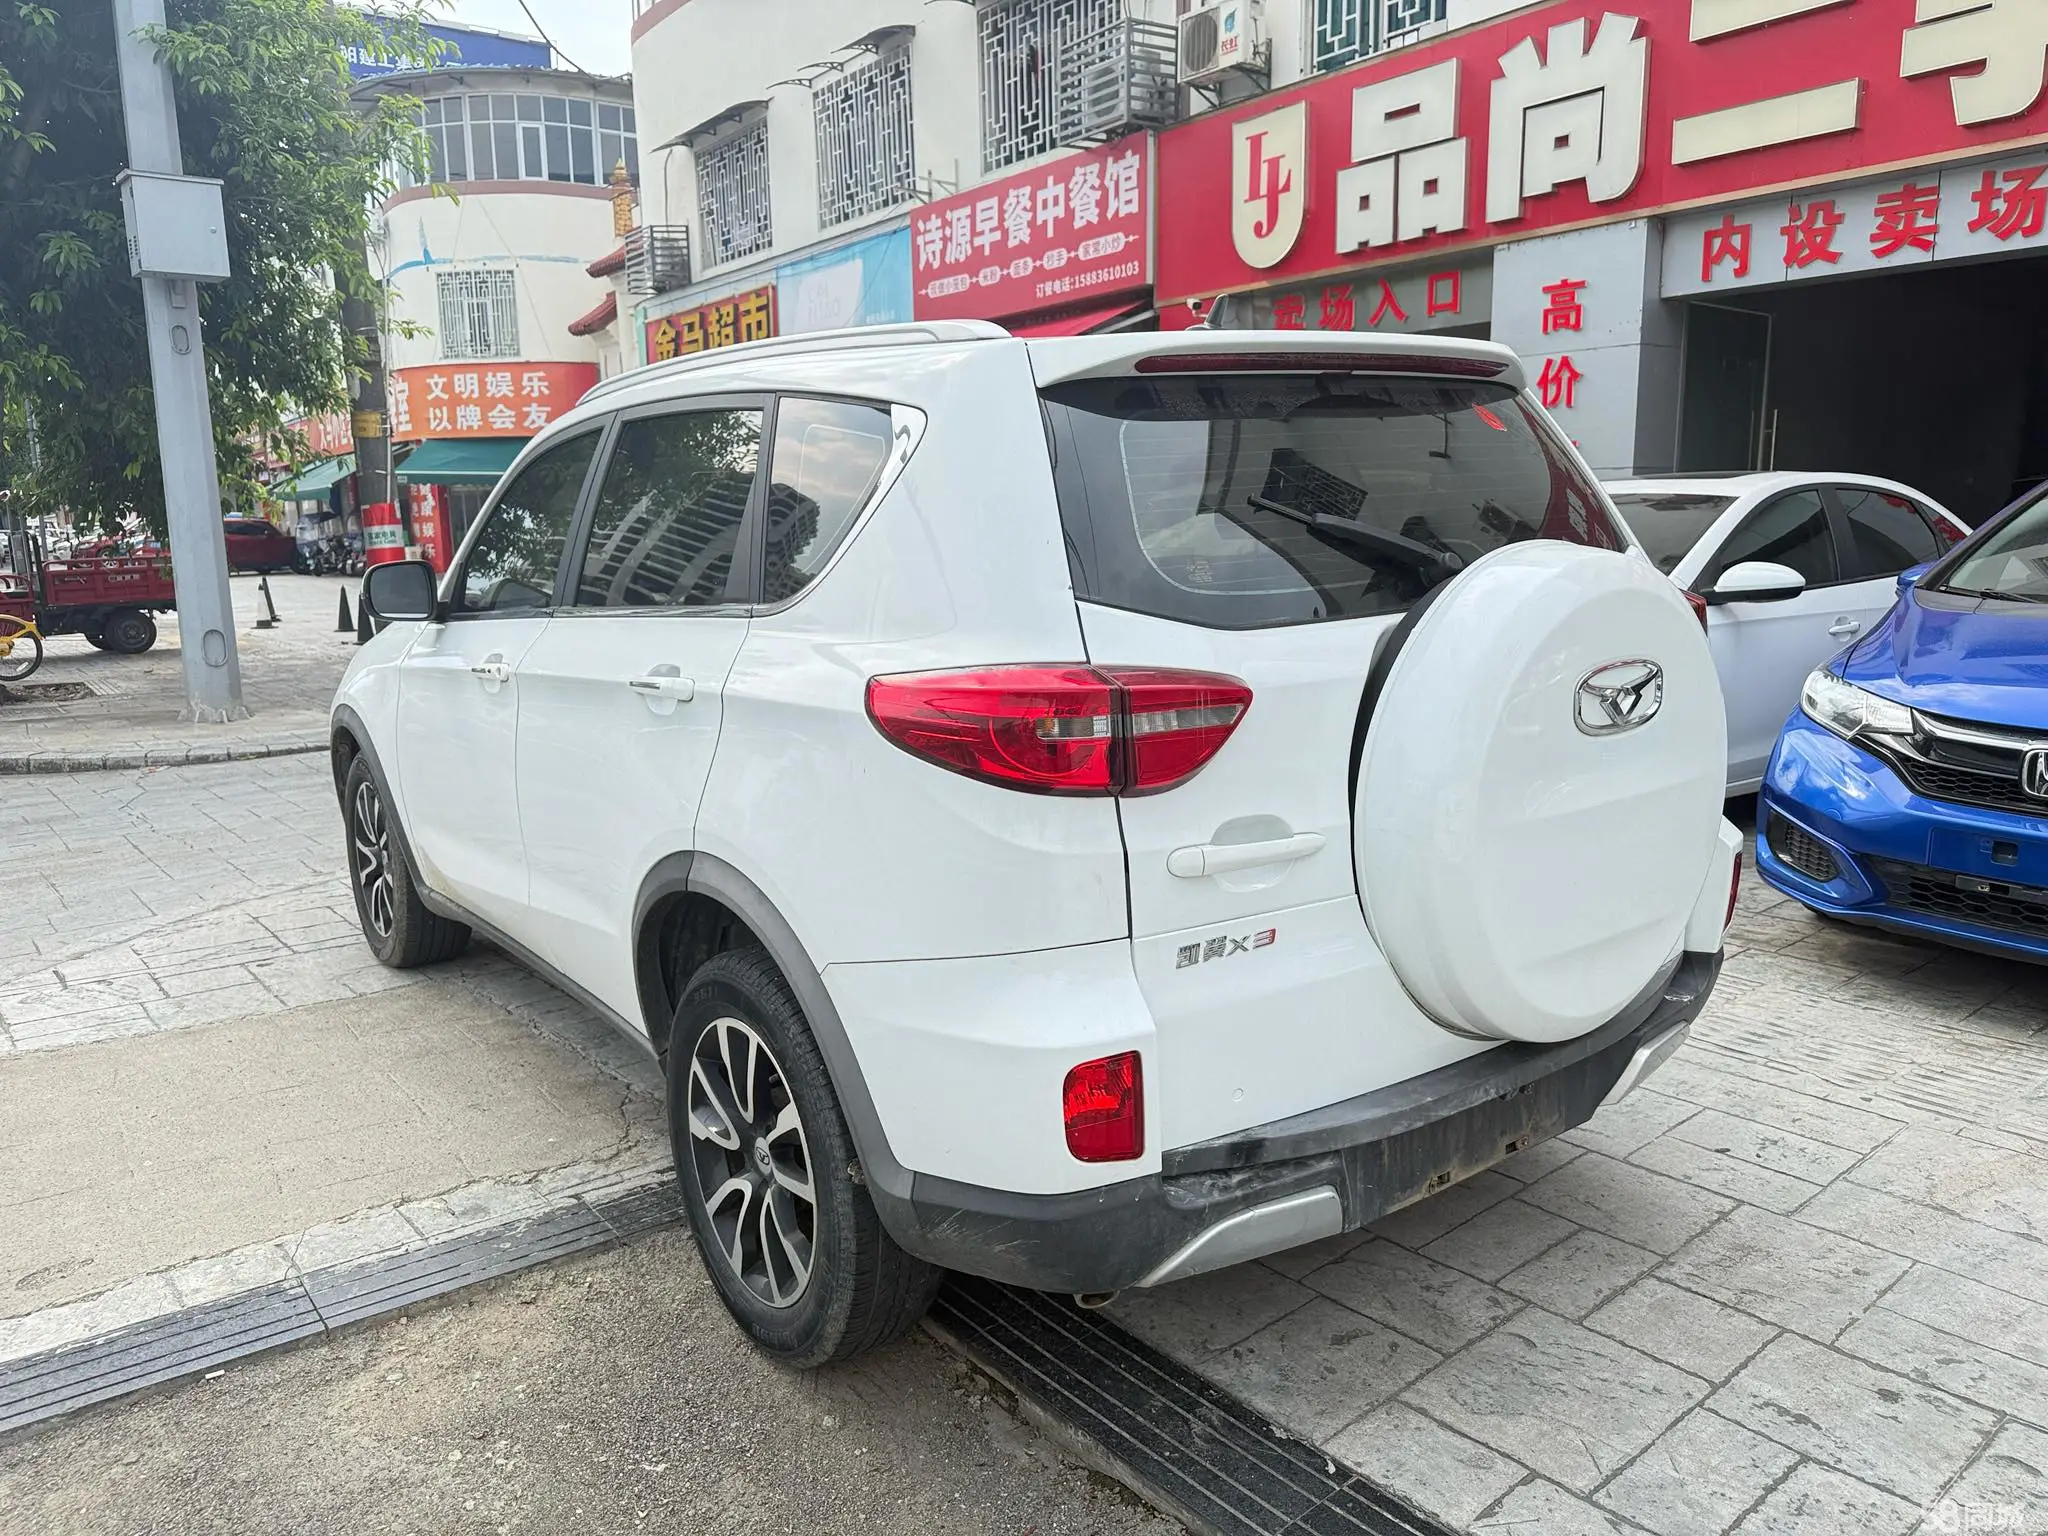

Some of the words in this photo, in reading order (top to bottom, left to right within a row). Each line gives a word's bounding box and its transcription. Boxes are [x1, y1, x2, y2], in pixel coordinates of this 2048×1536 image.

[916, 149, 1141, 271] 诗源早餐中餐馆
[1701, 165, 2048, 283] 内设卖场
[655, 292, 770, 359] 金马超市
[1272, 270, 1462, 331] 卖场入口
[426, 371, 550, 399] 文明娱乐
[429, 402, 552, 432] 以牌会友
